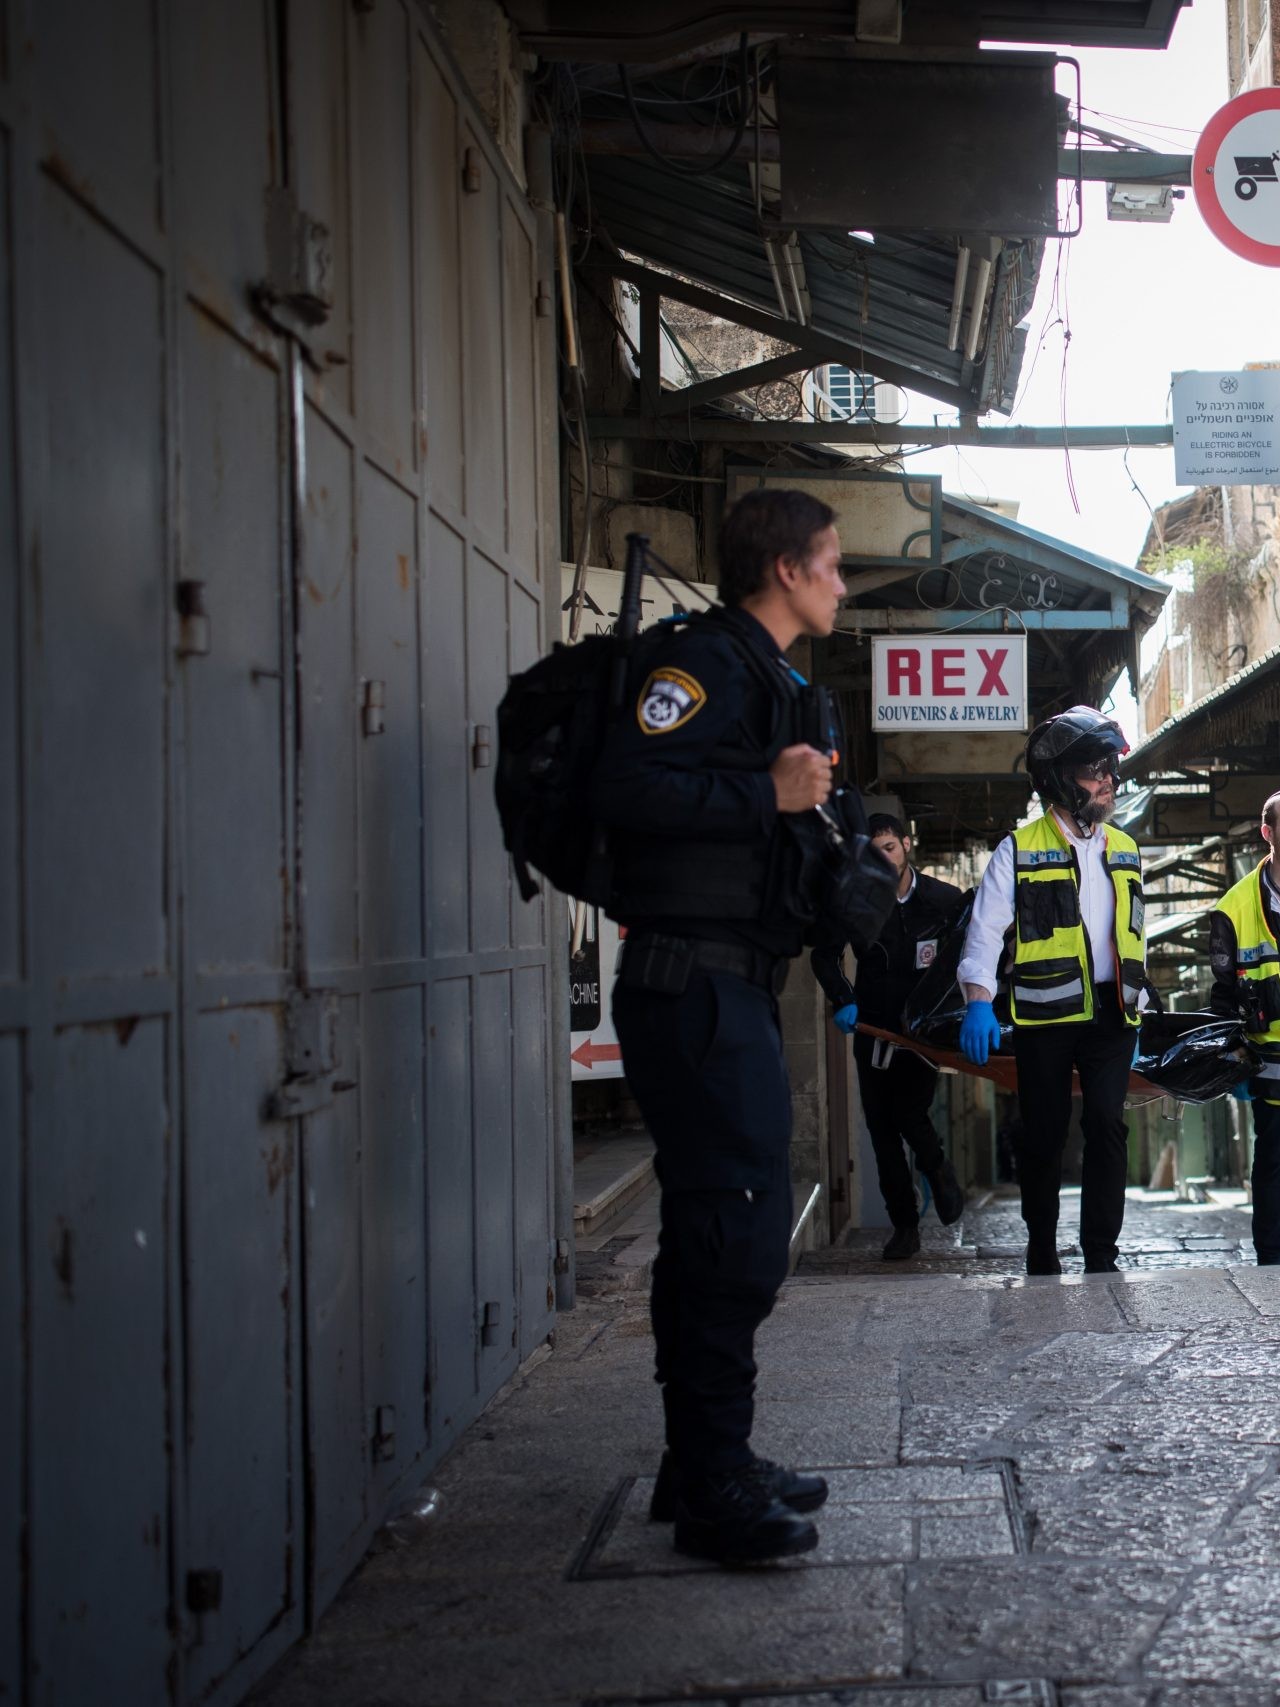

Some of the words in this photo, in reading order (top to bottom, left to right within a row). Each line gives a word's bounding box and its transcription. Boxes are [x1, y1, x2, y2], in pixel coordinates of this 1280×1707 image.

[1195, 401, 1207, 411] על
[1210, 402, 1235, 411] רכיבה
[1237, 401, 1265, 410] אסורה
[1186, 413, 1233, 424] חשמליים
[1235, 414, 1274, 423] אופניים
[1211, 431, 1239, 439] RIDING
[1190, 441, 1235, 449] ELLECTRIC
[1237, 440, 1272, 448] BICYCLE
[1205, 451, 1213, 459] IS
[1214, 450, 1261, 459] FORBIDDEN
[887, 648, 1010, 697] REX
[878, 705, 947, 721] SOUVENIRS
[949, 706, 959, 721] &
[961, 705, 1020, 721] JEWELRY
